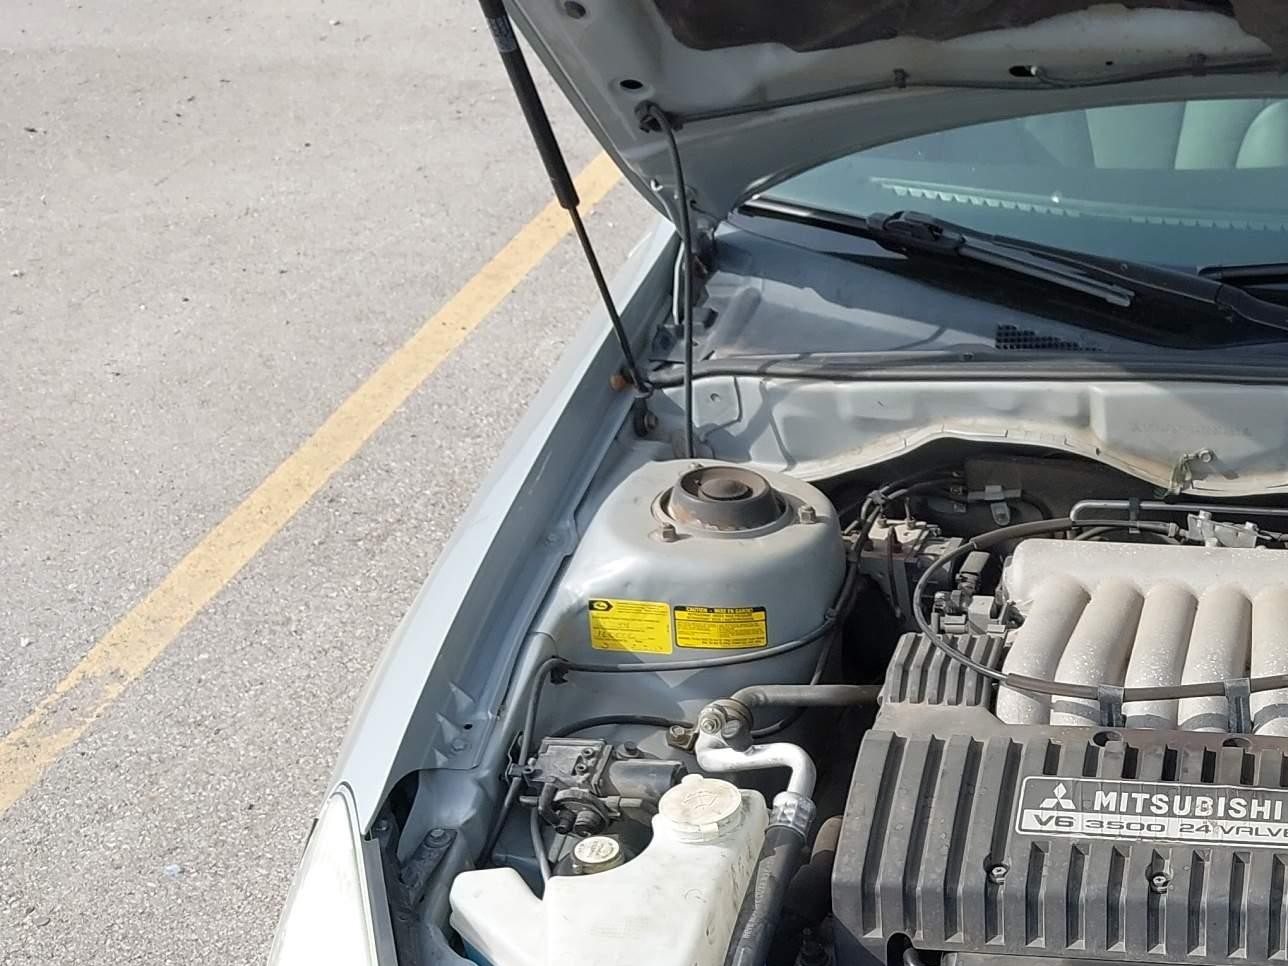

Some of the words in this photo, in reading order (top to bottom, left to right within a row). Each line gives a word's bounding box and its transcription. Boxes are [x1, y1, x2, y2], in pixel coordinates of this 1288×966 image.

[1093, 790, 1282, 820] MITSUBISHI
[1033, 815, 1074, 828] V6
[1085, 819, 1166, 832] 3500
[1179, 823, 1211, 834] 24
